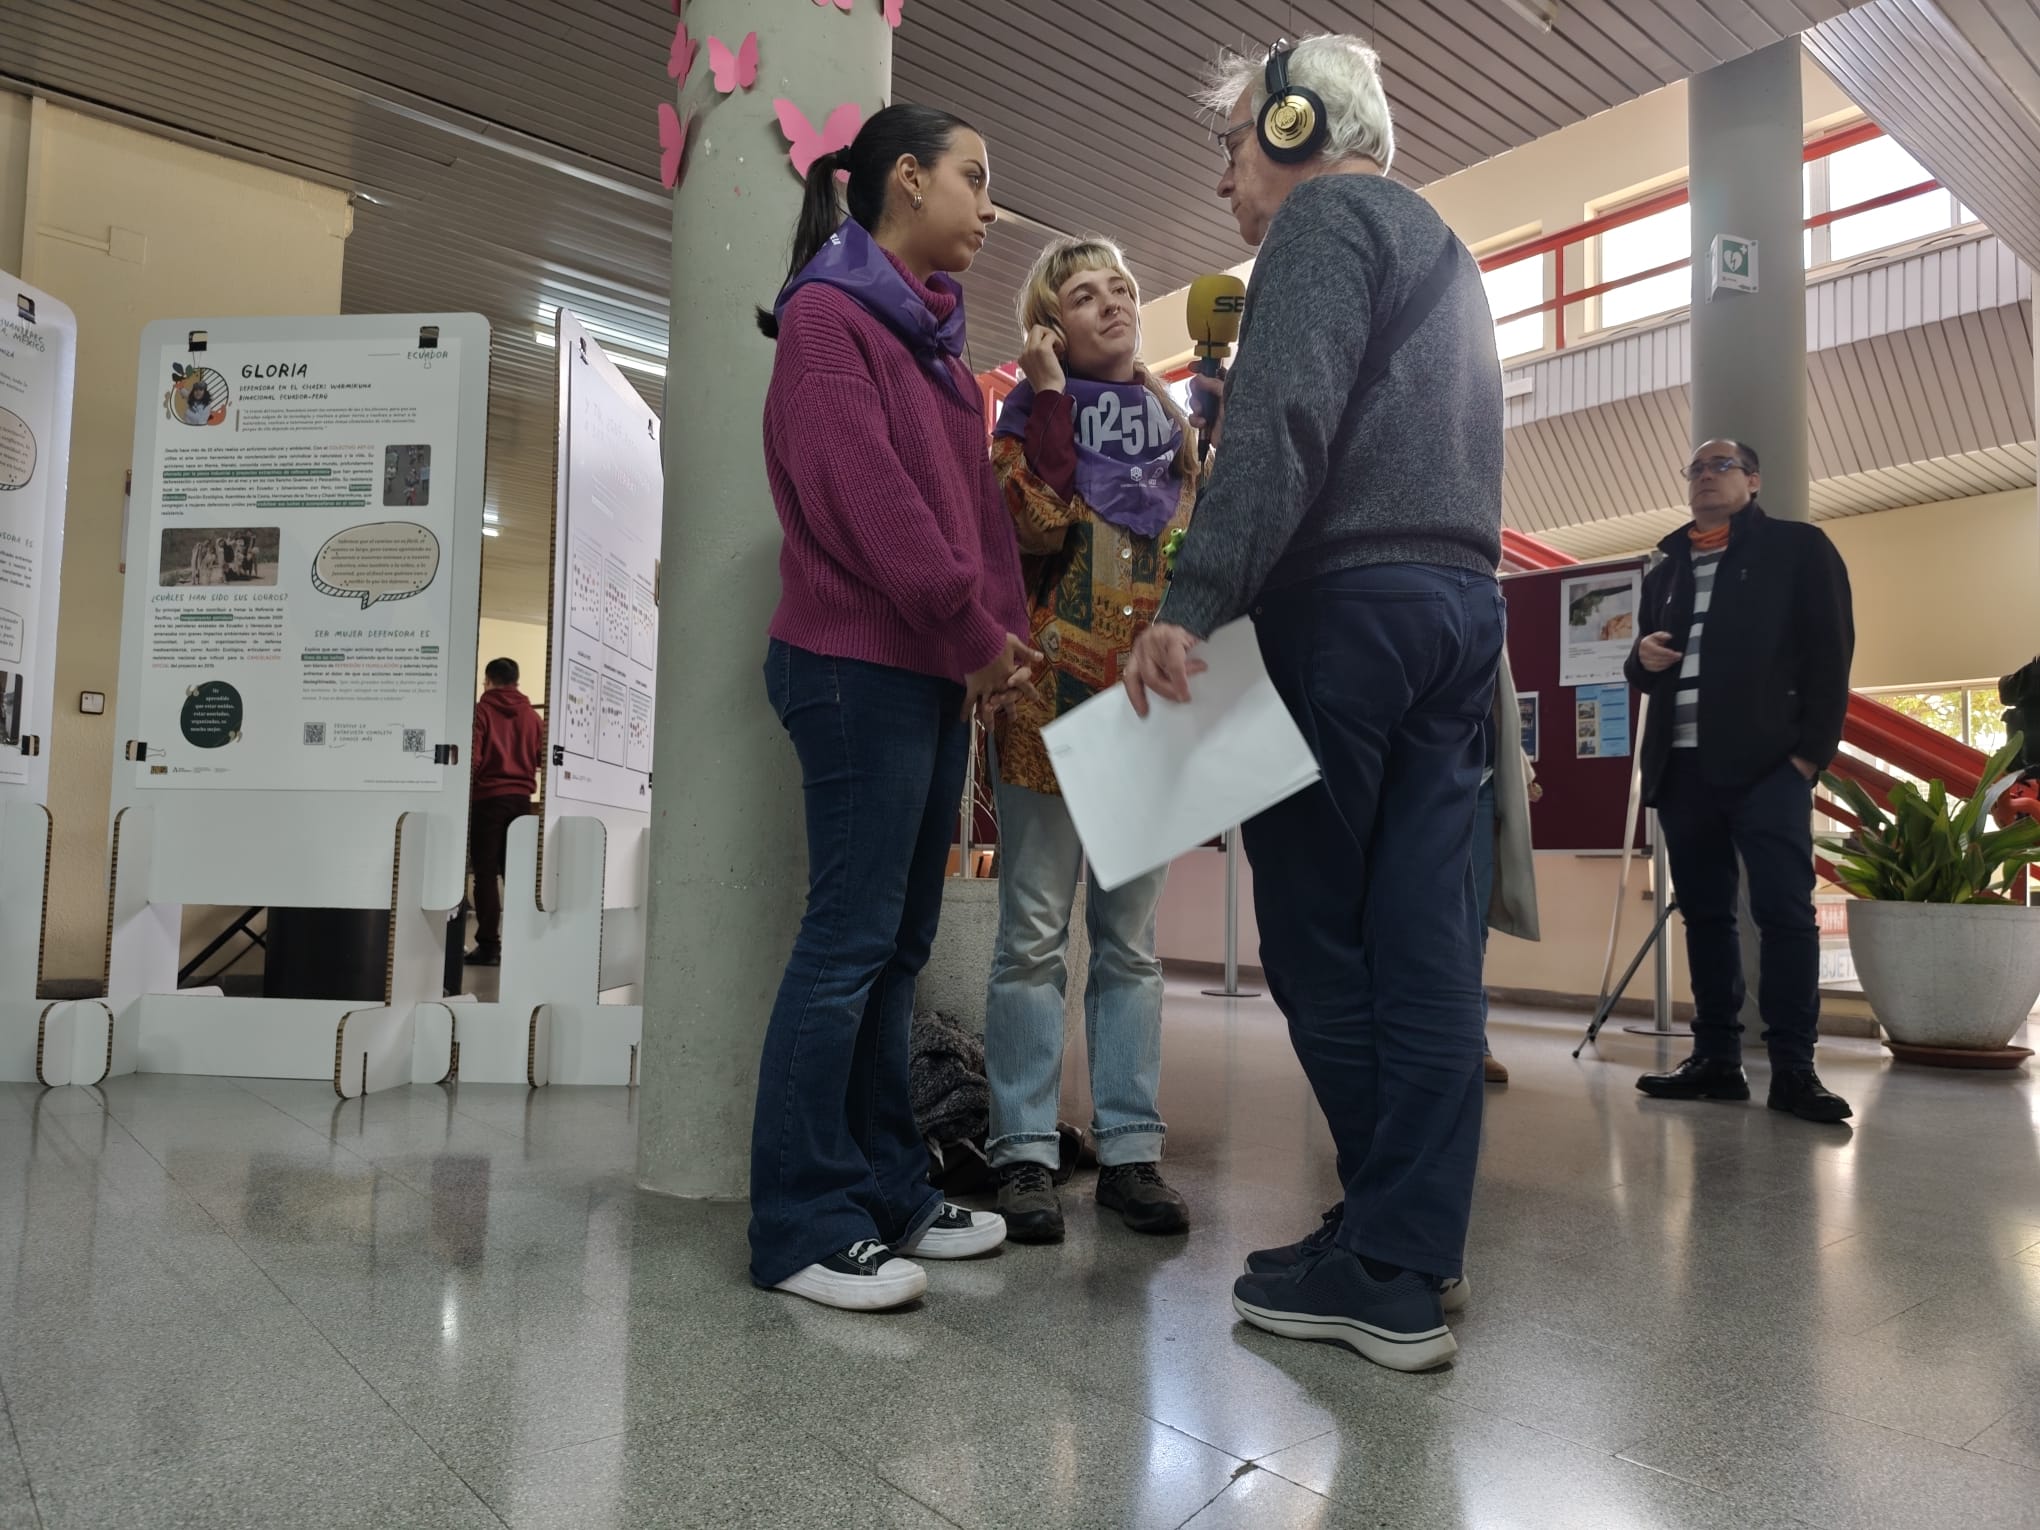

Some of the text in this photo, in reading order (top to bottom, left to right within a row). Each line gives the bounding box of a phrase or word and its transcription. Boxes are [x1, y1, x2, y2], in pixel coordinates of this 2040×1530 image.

[240, 362, 308, 379] GLORIA
[210, 593, 230, 602] SIDO
[234, 593, 248, 602] SUS
[334, 629, 363, 638] MUJER
[368, 629, 416, 638] DEFENSORA
[420, 629, 431, 638] ES
